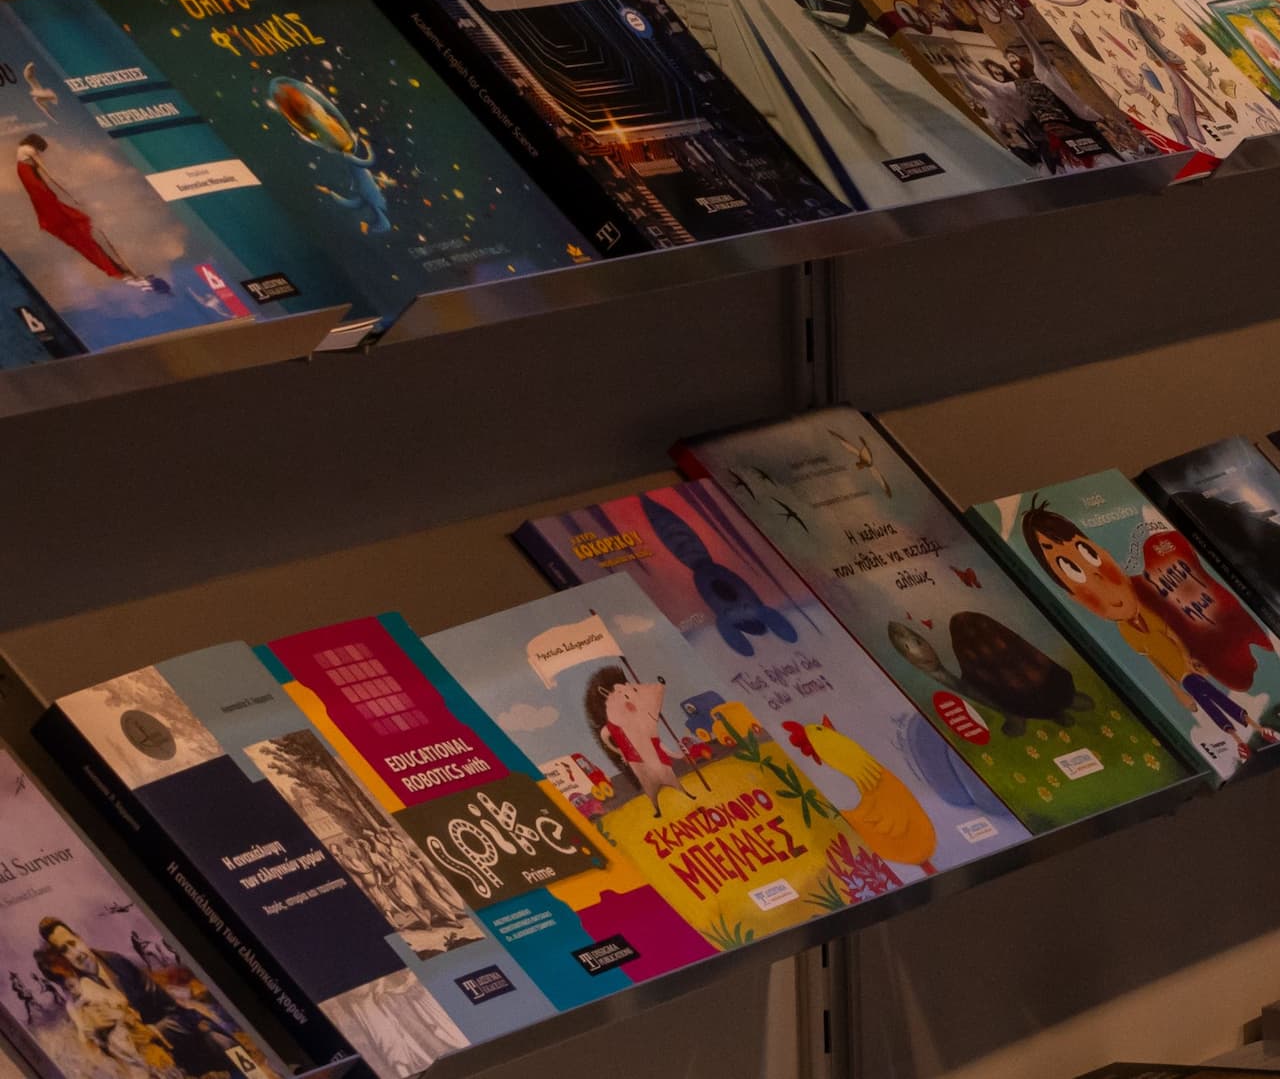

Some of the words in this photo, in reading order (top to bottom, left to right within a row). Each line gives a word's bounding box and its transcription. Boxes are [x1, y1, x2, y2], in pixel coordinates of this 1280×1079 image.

[384, 737, 474, 773] EDUCATIONAL
[401, 763, 467, 794] ROBOTICS
[460, 756, 492, 778] with
[30, 846, 76, 879] Survivor
[231, 839, 288, 869] ανακάλυψη
[669, 816, 808, 902] ΜΠΕΛΑΔΕΣ
[258, 859, 302, 887] ελληνικών
[520, 863, 557, 886] Prime
[173, 871, 226, 929] ανακάλυψη
